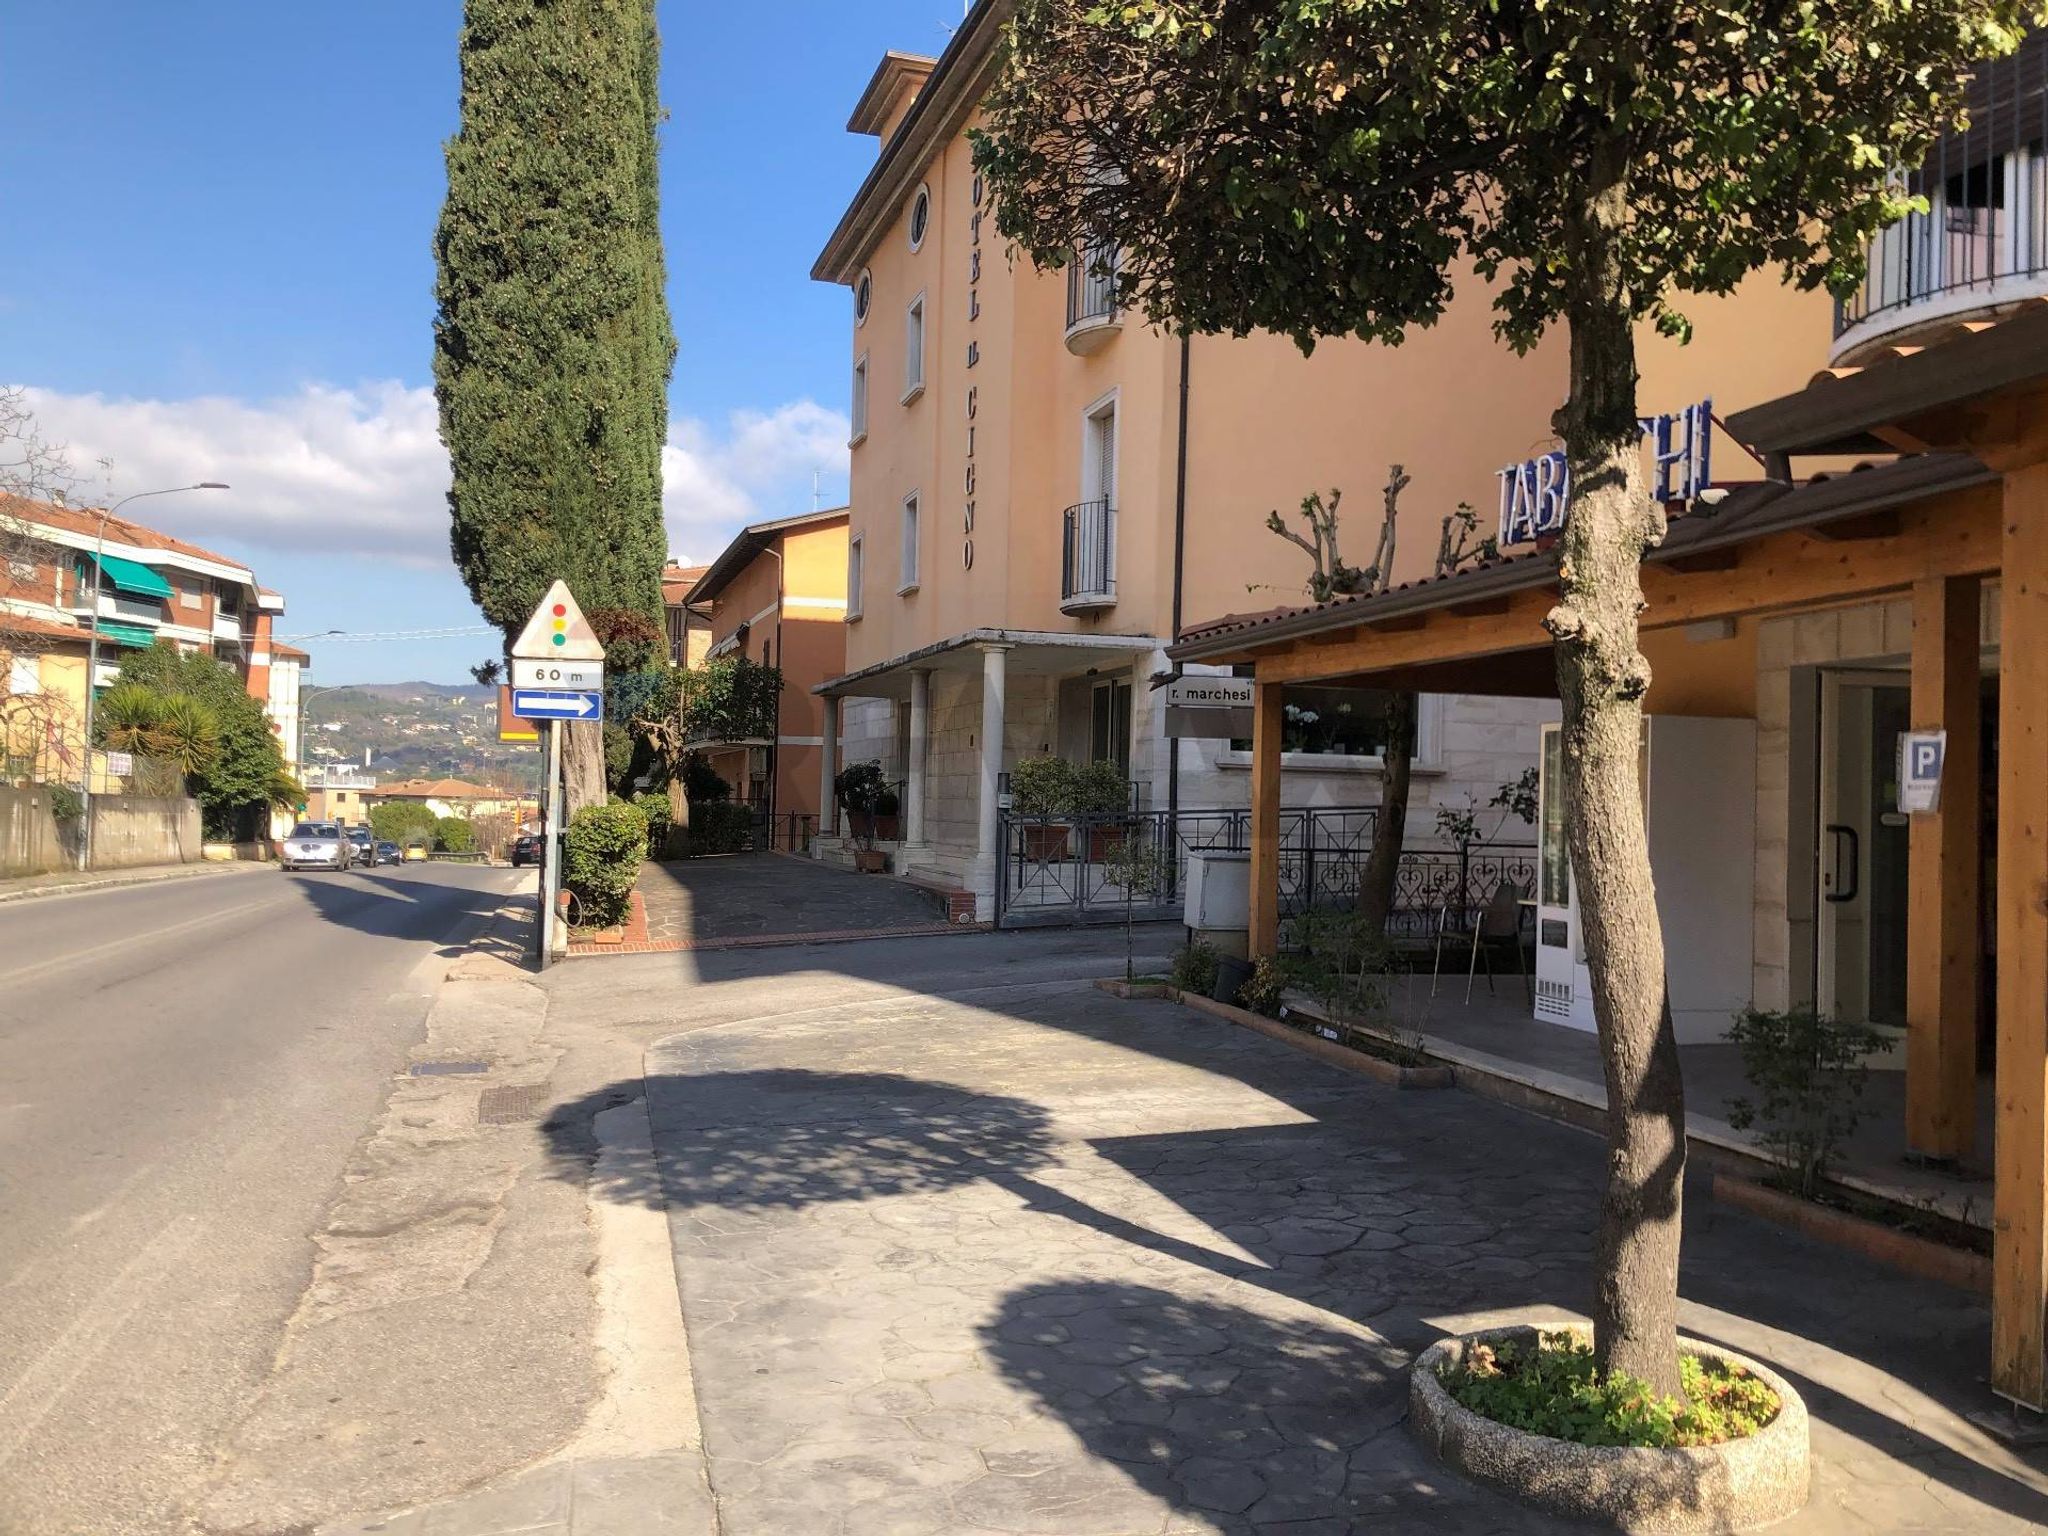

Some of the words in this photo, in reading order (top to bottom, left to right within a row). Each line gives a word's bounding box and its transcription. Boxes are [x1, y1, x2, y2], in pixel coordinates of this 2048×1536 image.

[969, 175, 983, 322] OTEL
[962, 386, 977, 571] CIGNO
[1495, 395, 1712, 547] TABHI
[535, 669, 561, 681] 60
[570, 673, 583, 682] m
[1186, 688, 1250, 700] marchesi
[1918, 746, 1936, 776] P
